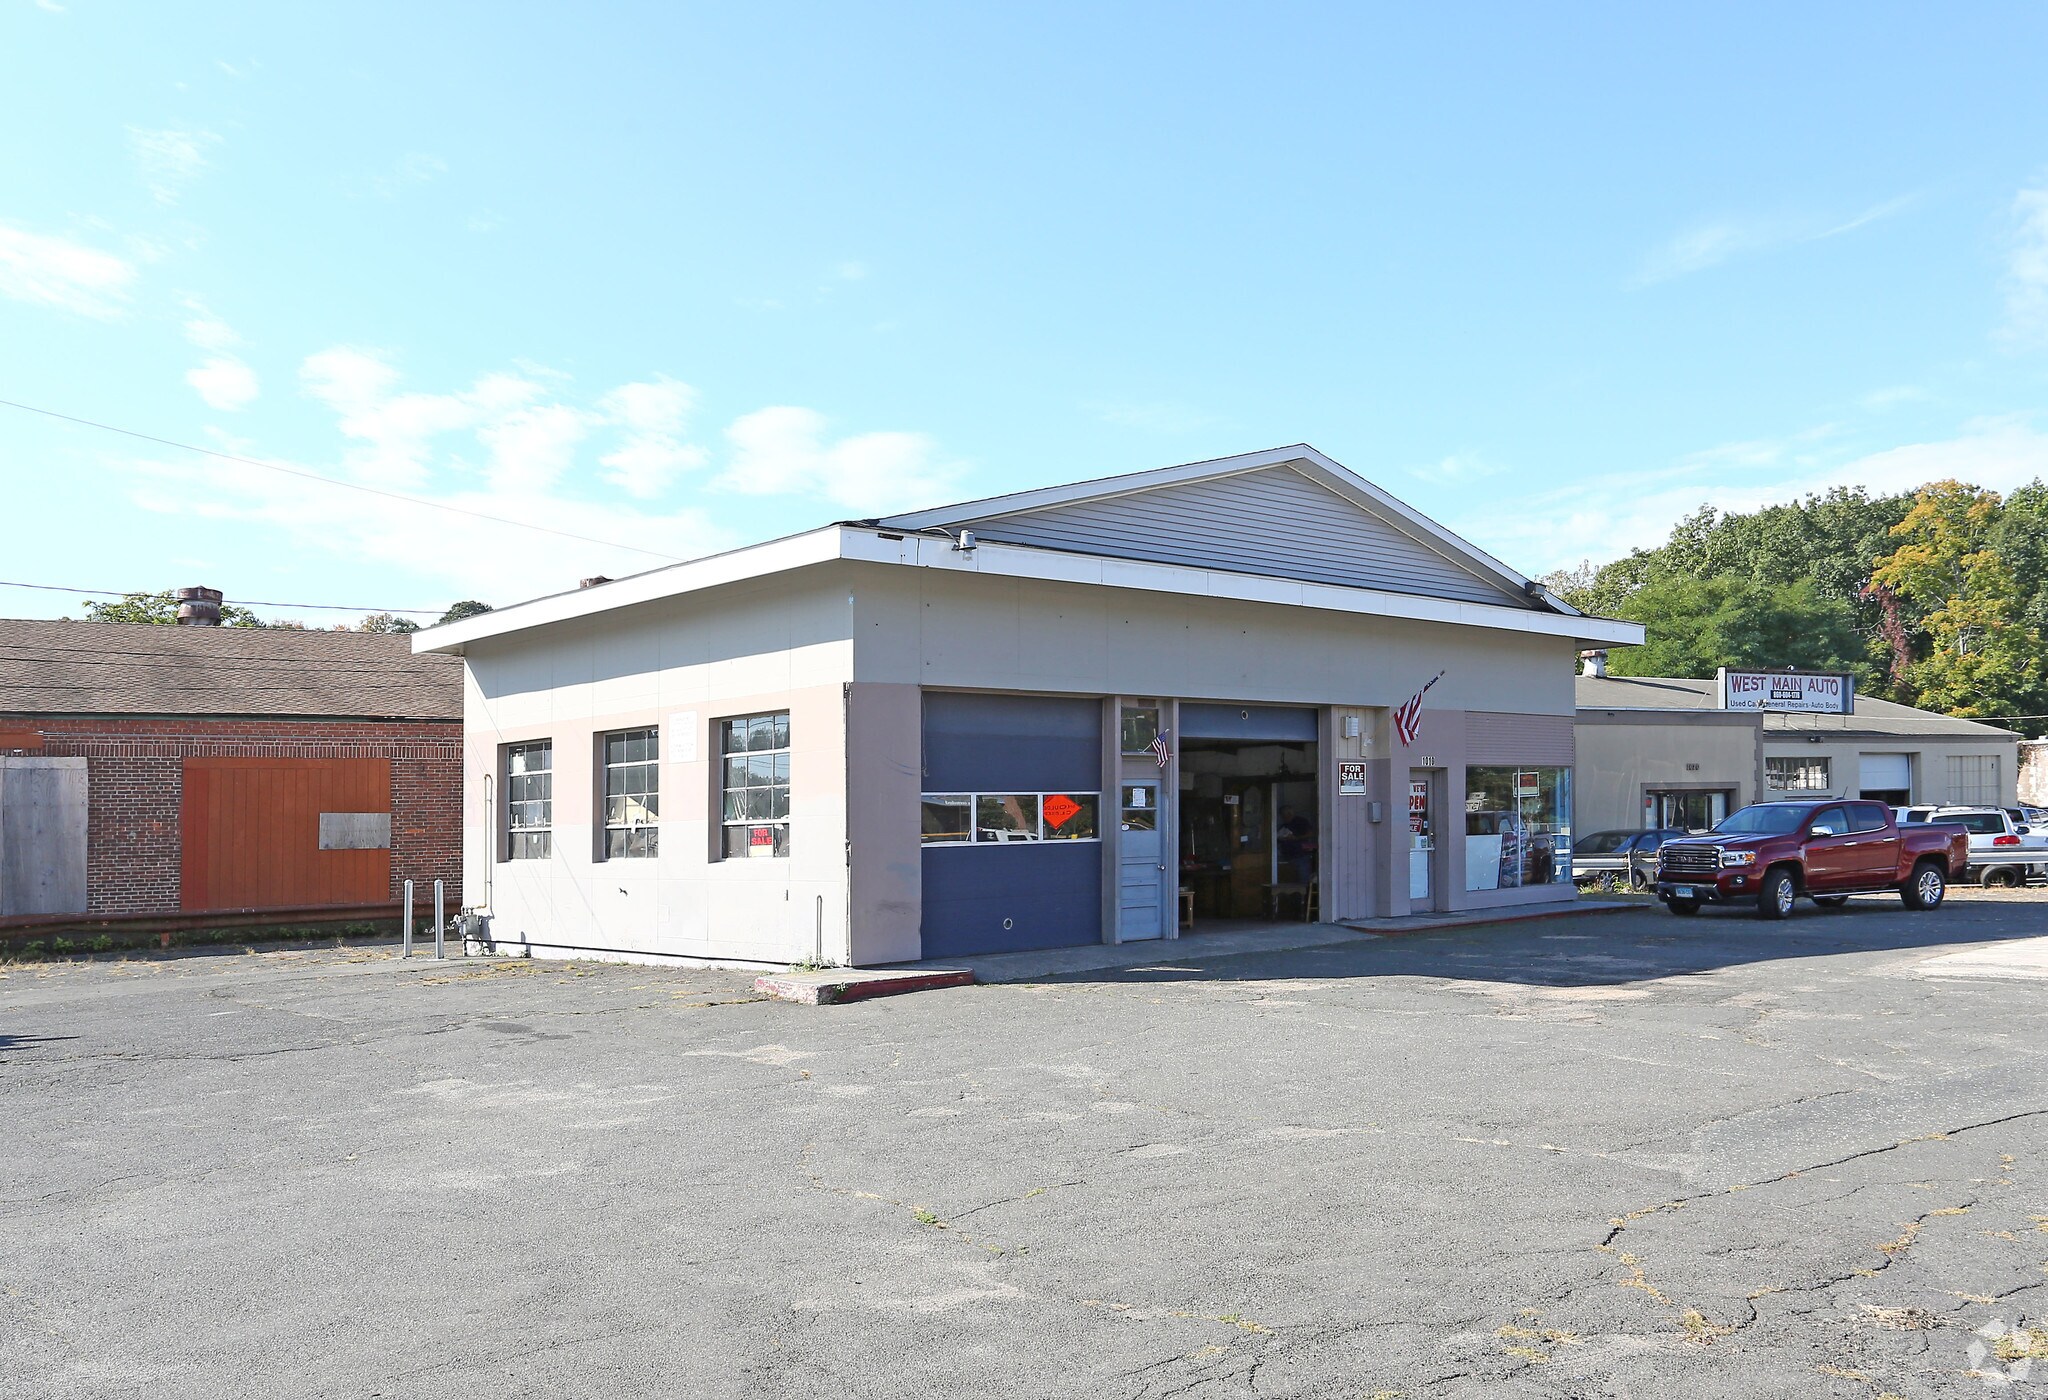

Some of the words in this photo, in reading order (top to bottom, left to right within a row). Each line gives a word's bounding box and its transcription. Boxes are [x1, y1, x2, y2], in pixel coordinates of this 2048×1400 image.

[1731, 676, 1766, 693] WEST
[1772, 677, 1802, 691] MAIN
[1808, 678, 1839, 696] AUTO
[1826, 702, 1839, 710] Body
[1341, 772, 1364, 780] SALE
[1409, 795, 1426, 810] PEN
[754, 829, 768, 837] FOR
[751, 837, 772, 845] SALE
